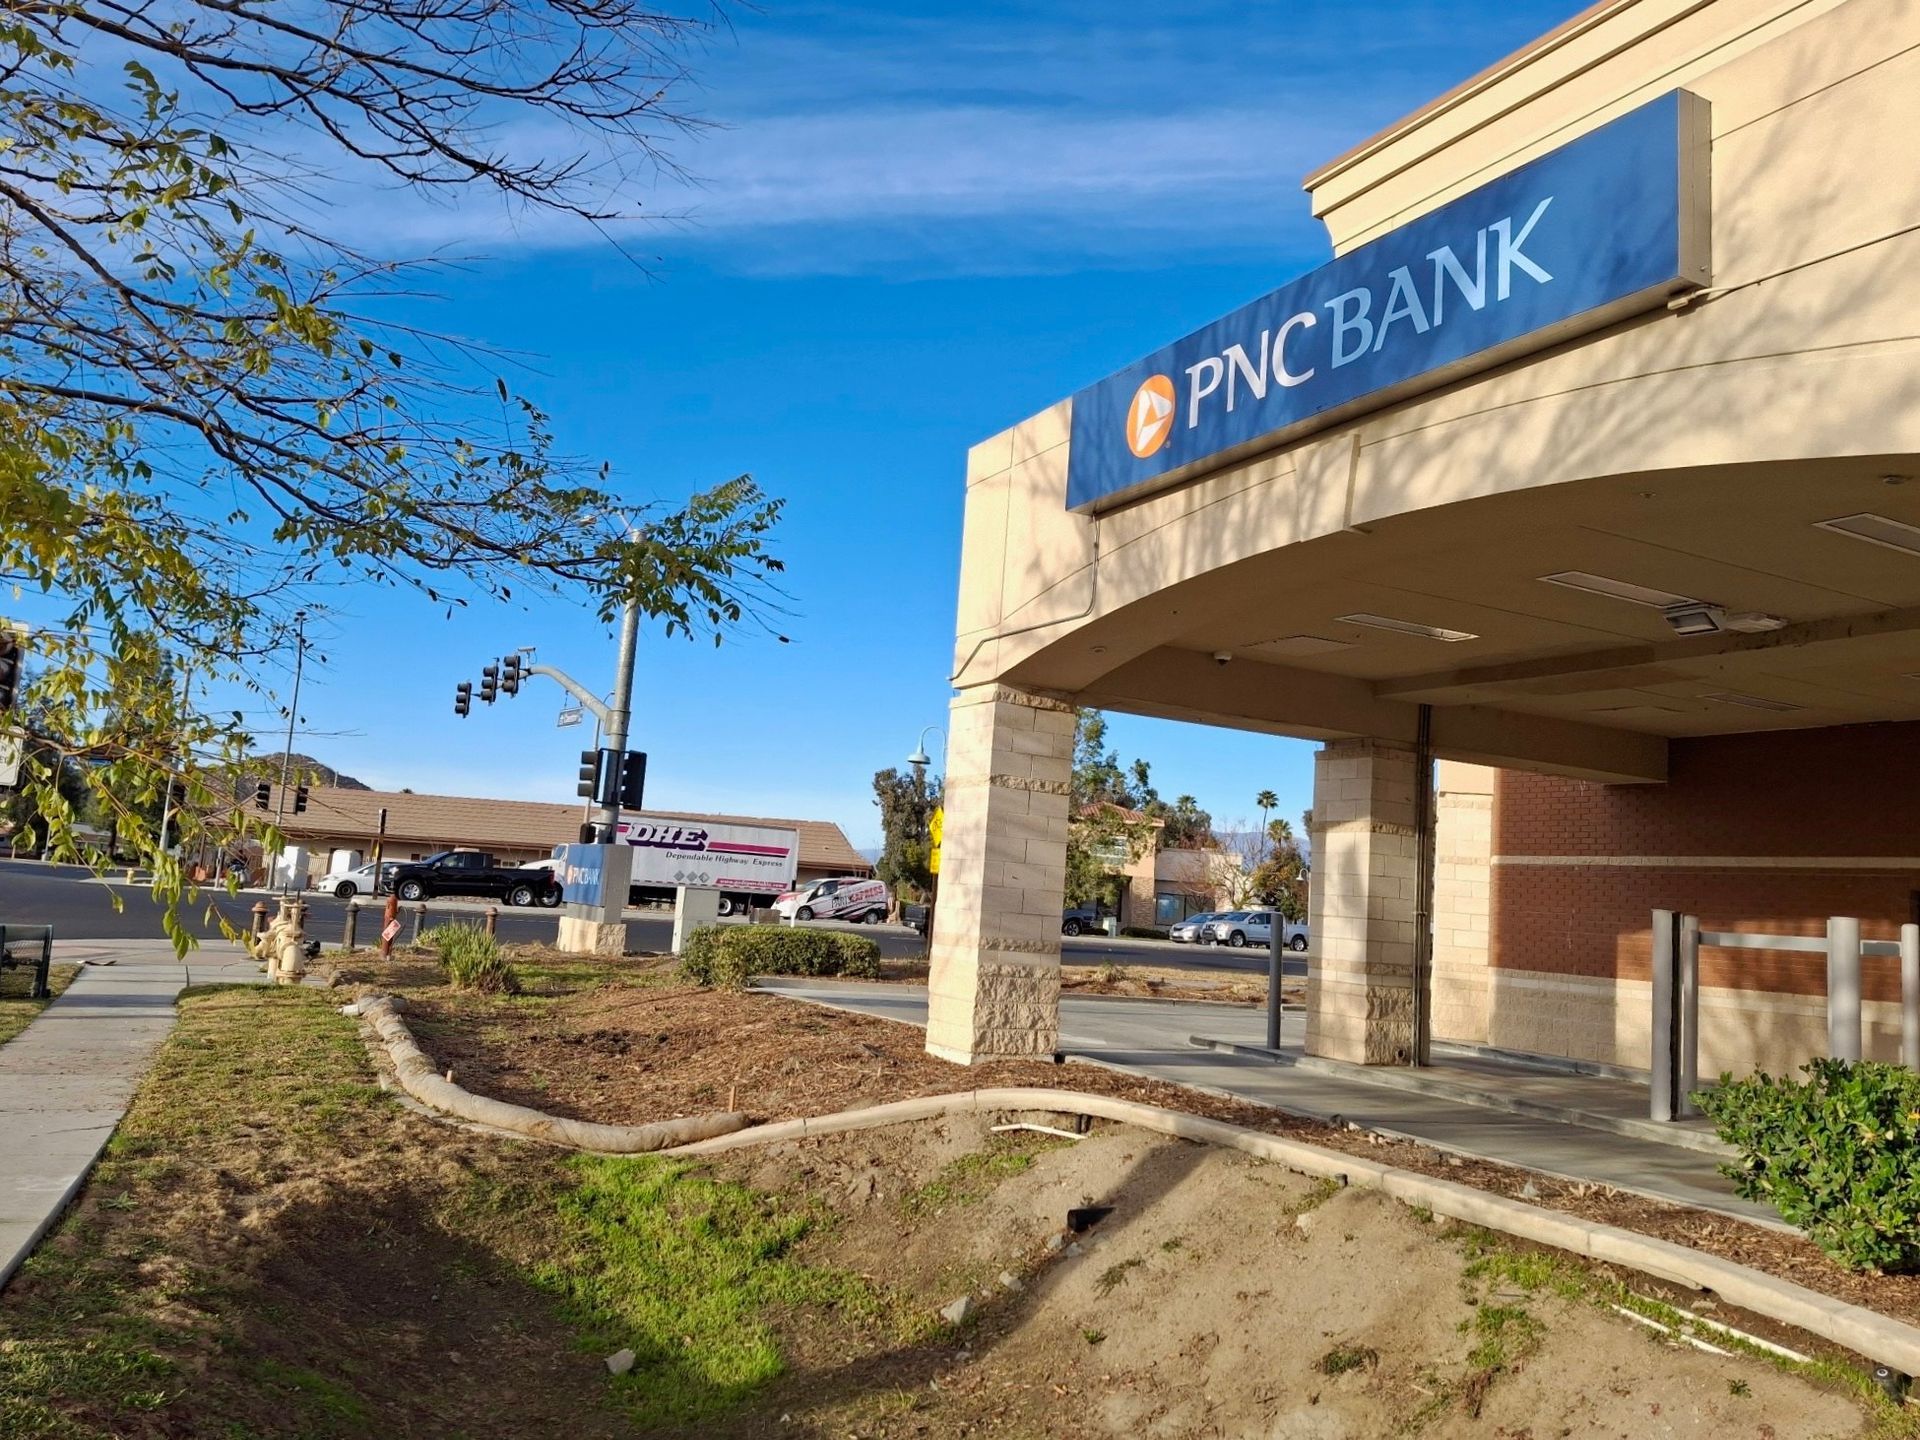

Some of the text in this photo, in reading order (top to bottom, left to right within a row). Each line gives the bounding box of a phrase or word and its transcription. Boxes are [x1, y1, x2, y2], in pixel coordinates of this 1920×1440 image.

[1185, 196, 1554, 429] PNC BANK
[626, 823, 708, 851] DHE
[665, 851, 783, 867] Dependable Highway Express
